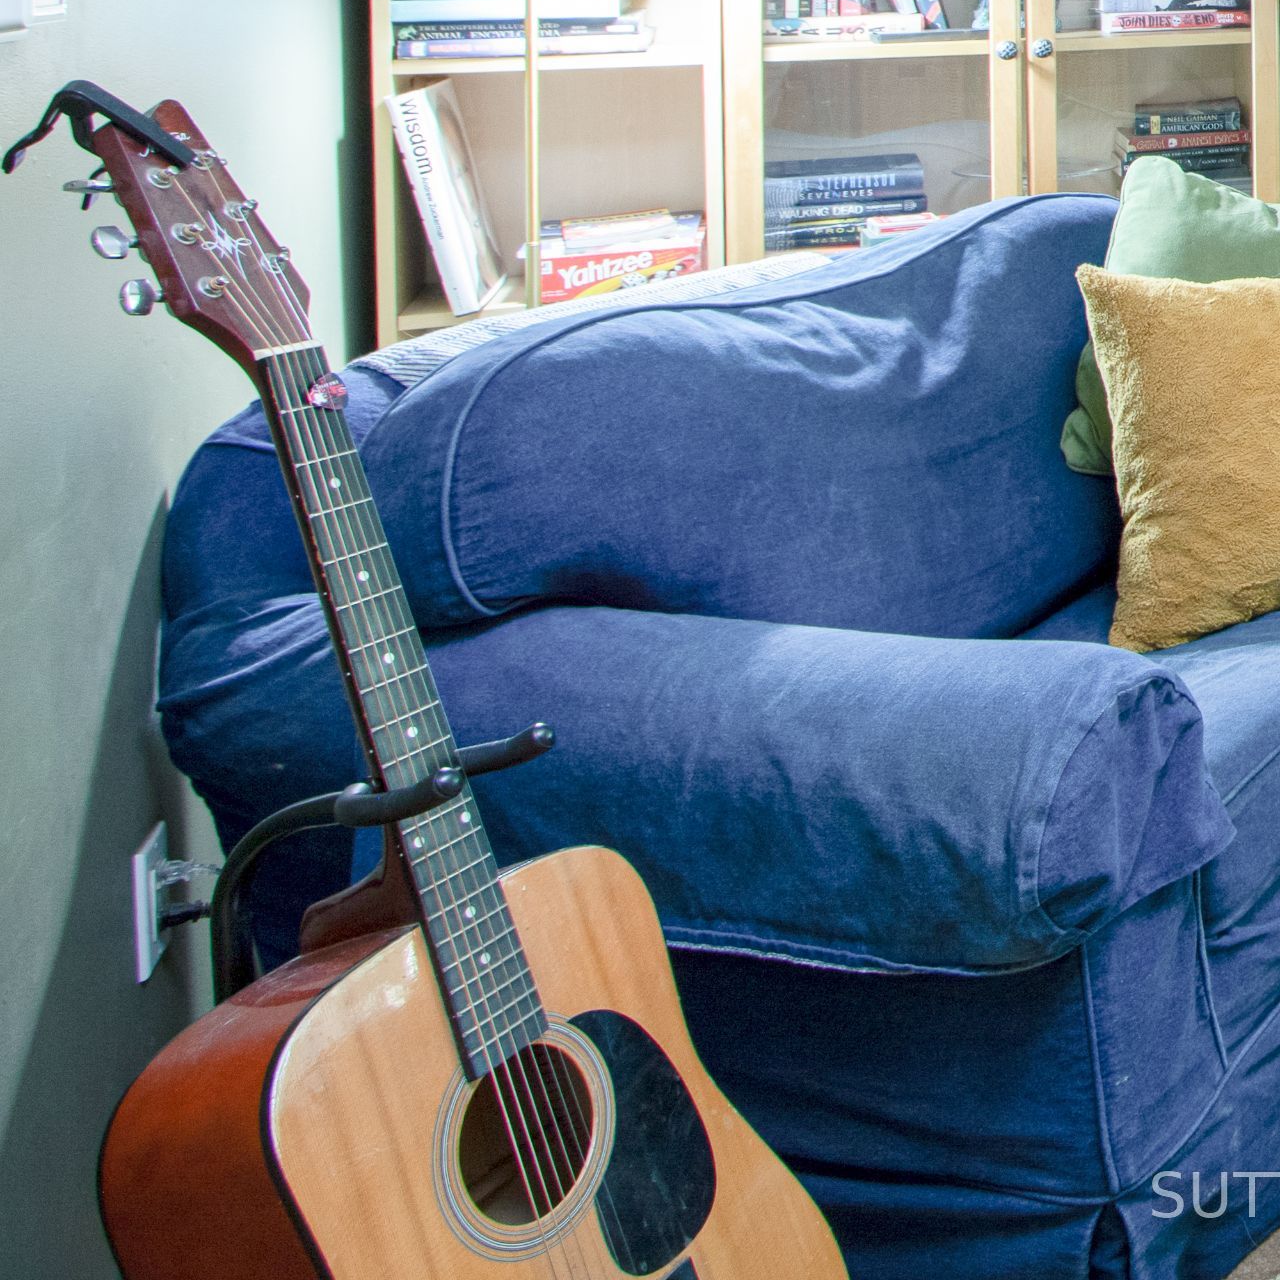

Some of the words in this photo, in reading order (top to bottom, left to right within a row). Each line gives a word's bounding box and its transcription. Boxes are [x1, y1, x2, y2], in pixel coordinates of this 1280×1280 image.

[1118, 16, 1146, 28] JOHN
[1148, 15, 1171, 28] DIES
[1194, 14, 1215, 24] END
[417, 30, 464, 39] ANIMAL
[1186, 114, 1218, 122] GAIMAN
[1161, 124, 1201, 133] AMERICAN
[1202, 122, 1224, 131] GODS
[399, 96, 433, 176] Wisdom
[1181, 135, 1212, 147] ANANSI
[1214, 133, 1239, 145] BOYS
[817, 172, 896, 190] STEPHENSON
[799, 188, 874, 201] SEVENEVES
[779, 206, 830, 219] WALKING
[832, 204, 864, 216] DEAD
[557, 251, 653, 289] Yahtzee
